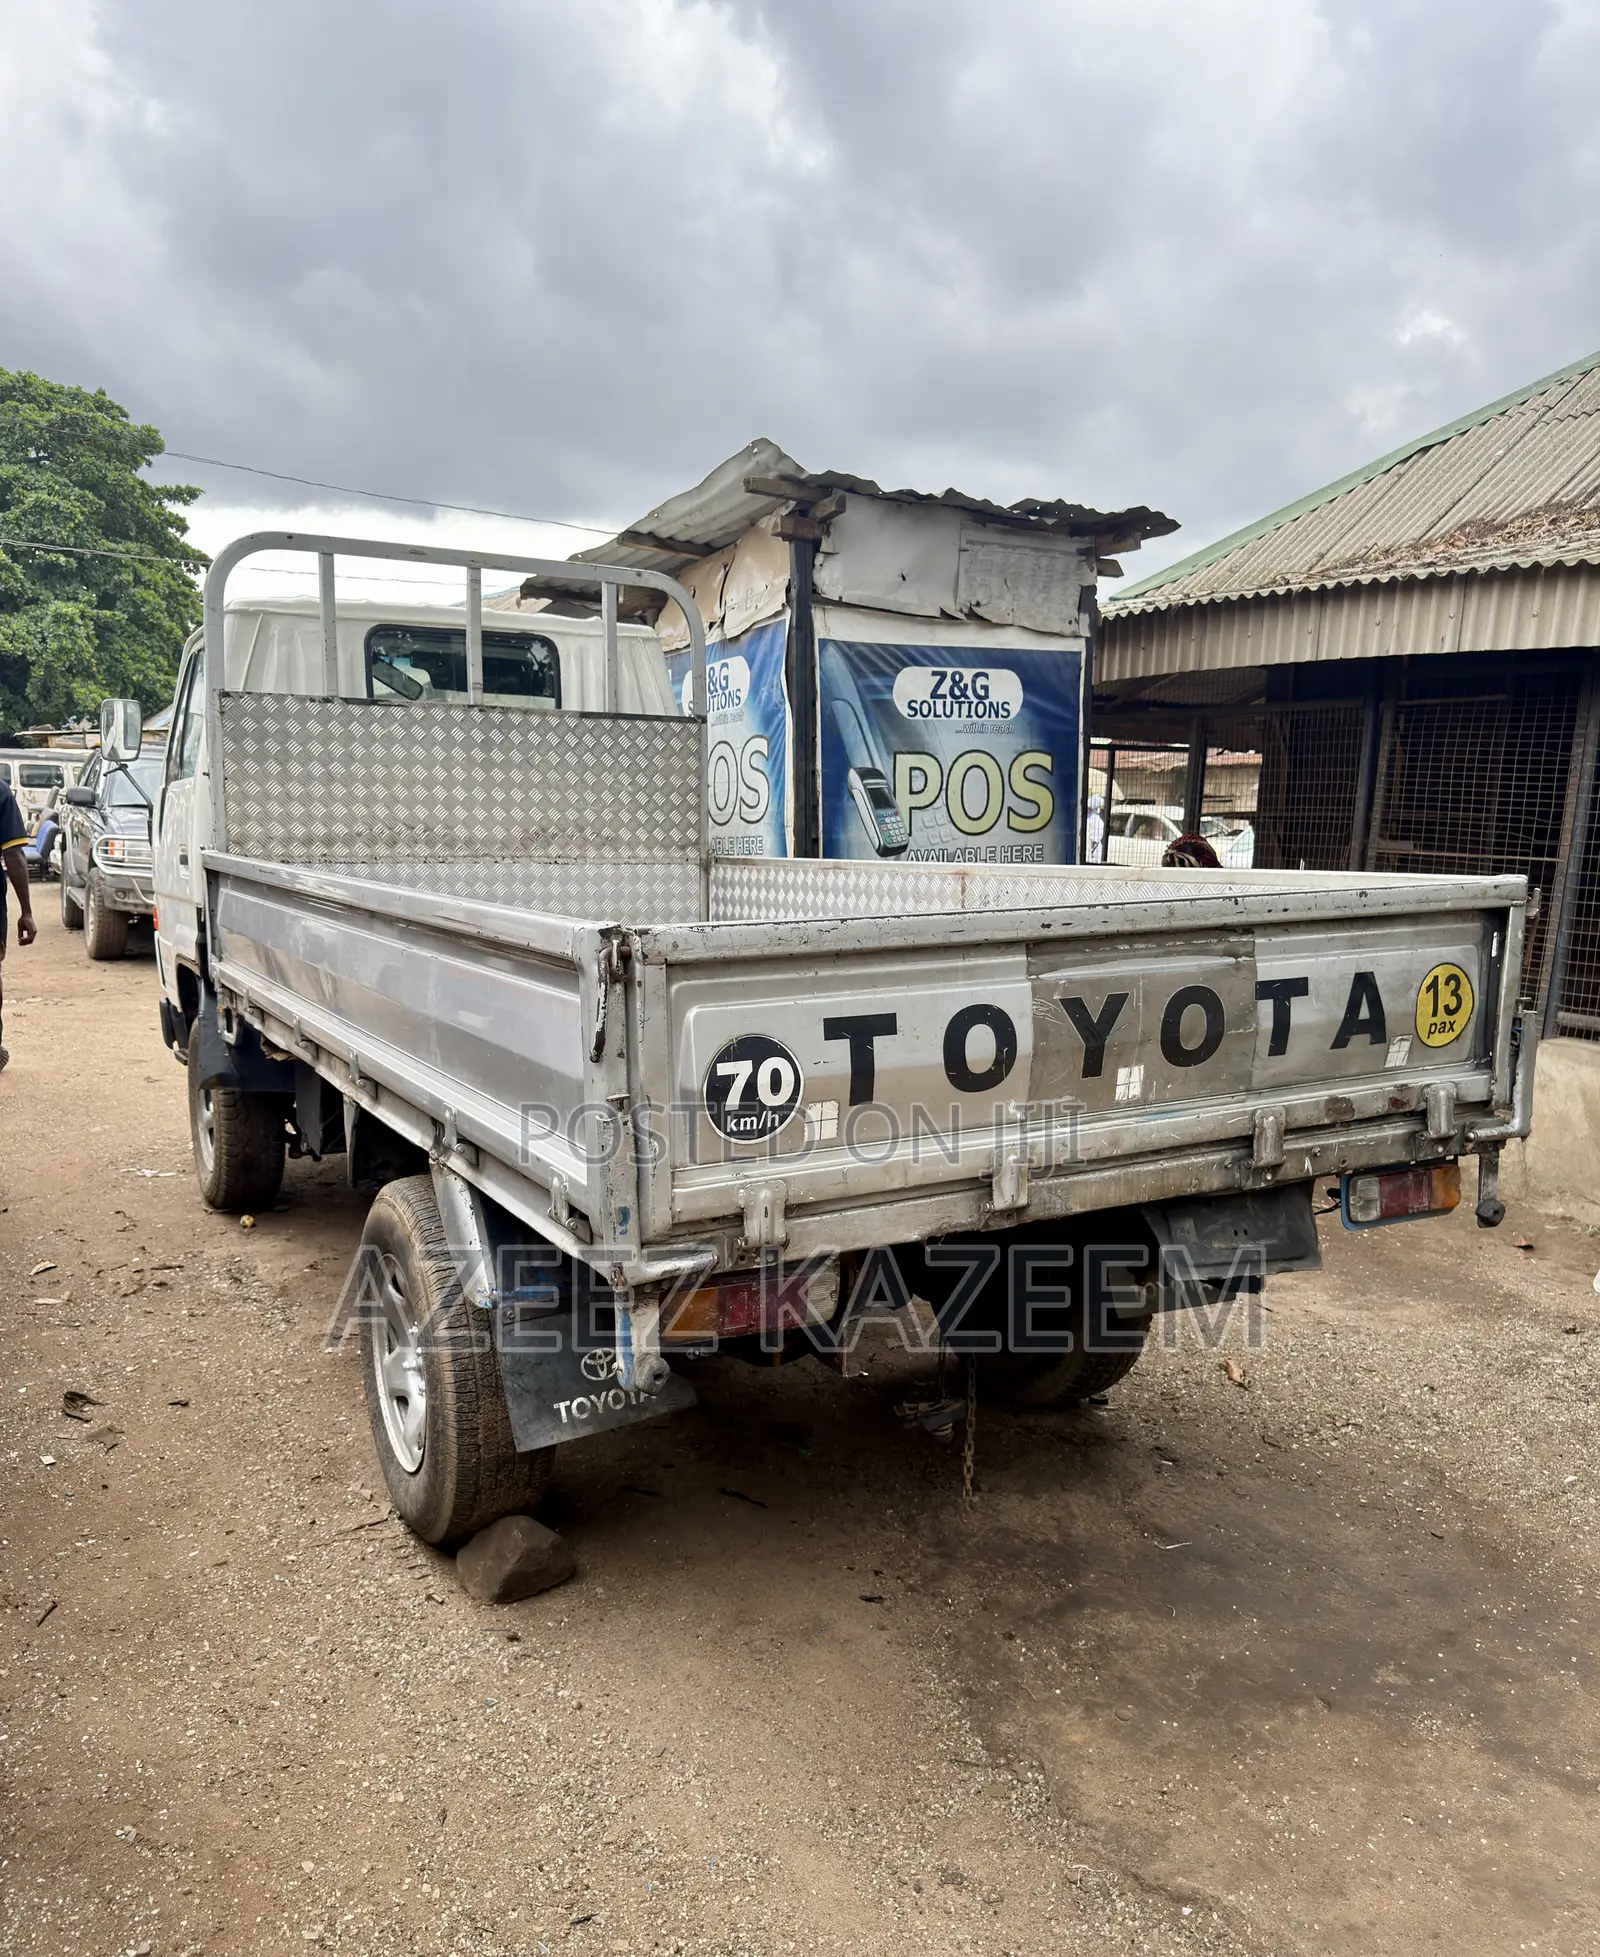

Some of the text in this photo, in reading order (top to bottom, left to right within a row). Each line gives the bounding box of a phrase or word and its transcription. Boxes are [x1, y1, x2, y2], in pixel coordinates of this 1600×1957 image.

[930, 670, 990, 701] Z&G
[907, 699, 1011, 719] SOLUTIONS
[989, 722, 1015, 734] reach
[893, 749, 1055, 836] POS
[736, 836, 764, 856] HERE
[907, 844, 1044, 863] AVAILABLE HERE
[1425, 973, 1463, 1018] 13
[822, 971, 1387, 1106] TOYOTA
[1427, 1020, 1456, 1039] pax
[716, 1056, 795, 1110] 70
[726, 1112, 779, 1133] km/h
